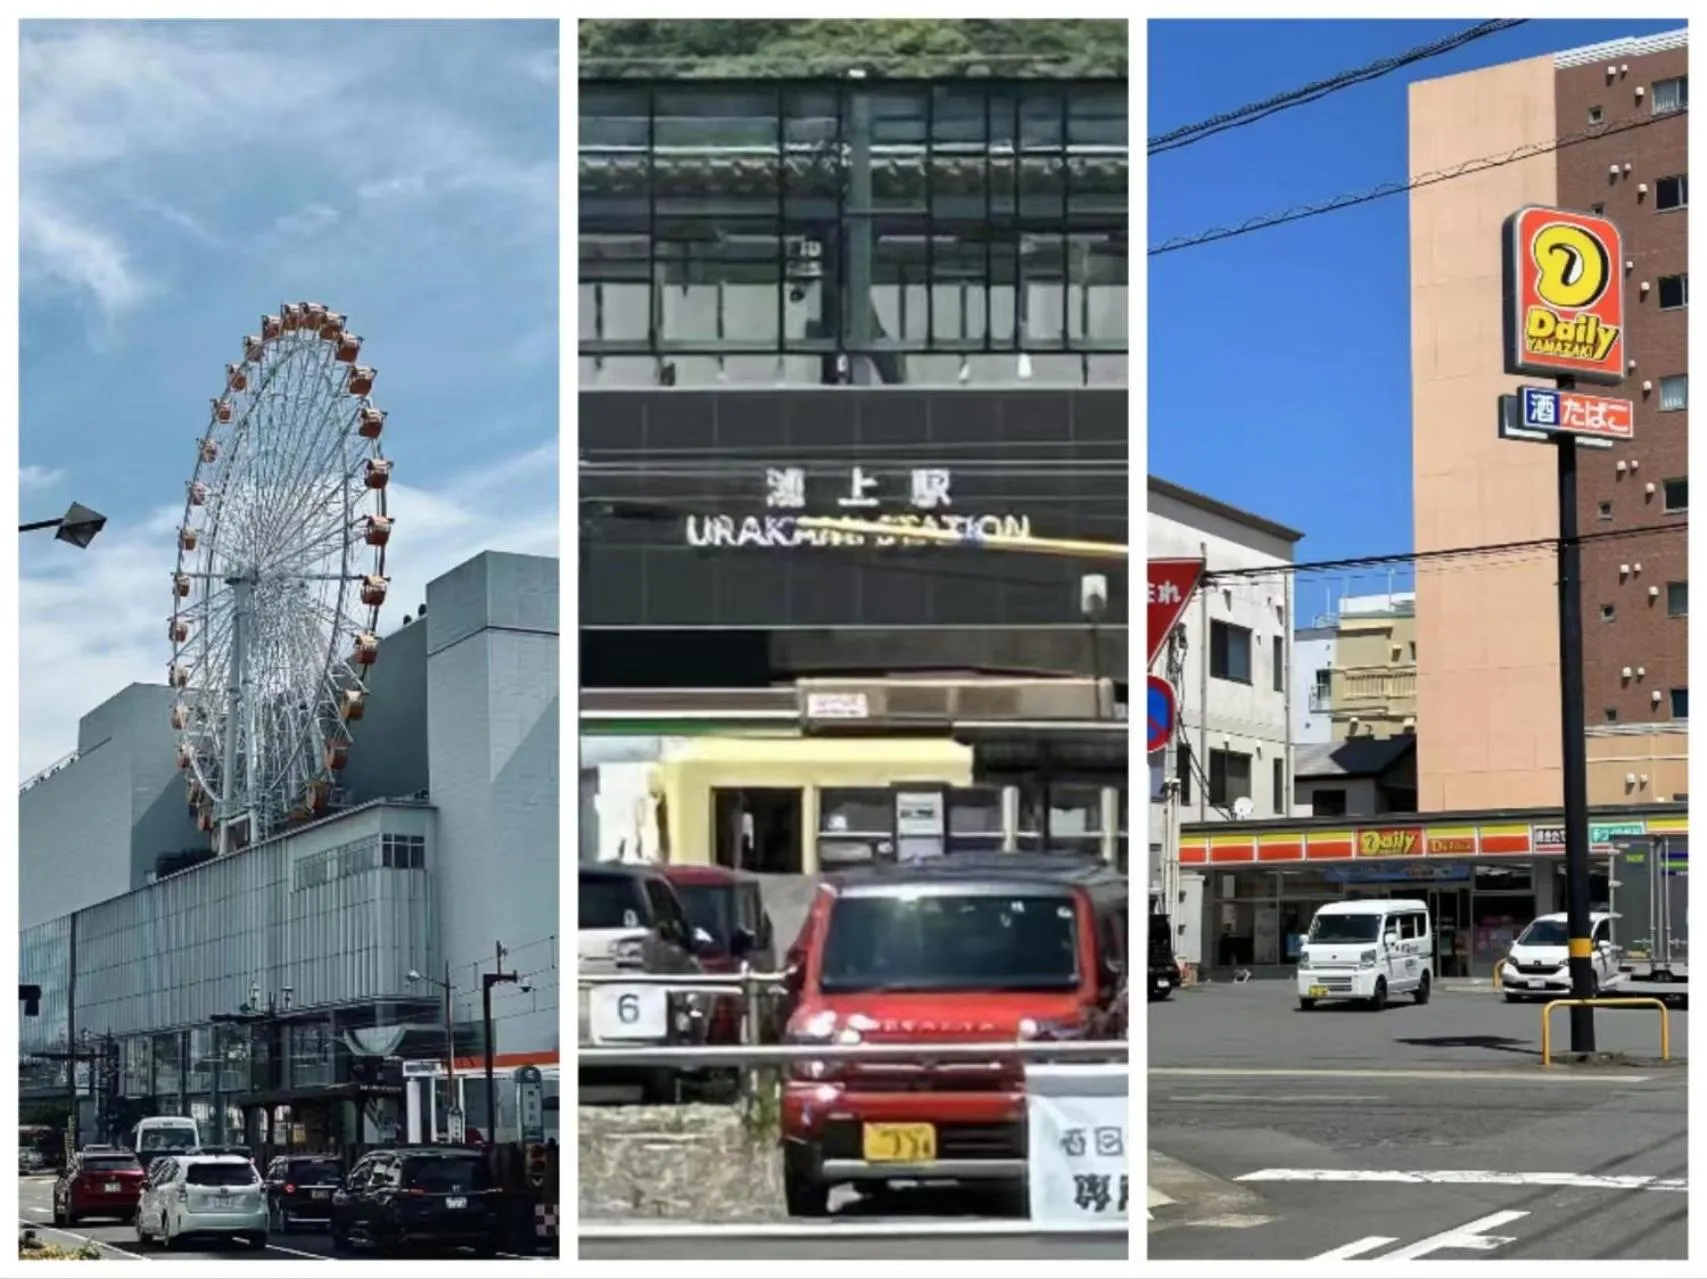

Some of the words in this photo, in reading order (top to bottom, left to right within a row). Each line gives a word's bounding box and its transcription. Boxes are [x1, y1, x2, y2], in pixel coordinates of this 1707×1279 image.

[1527, 337, 1595, 359] YAMAZAKI
[1528, 308, 1619, 360] Daily
[1530, 394, 1556, 424] 酒
[1563, 398, 1630, 433] たばこ
[1361, 829, 1417, 855] Daily
[617, 993, 640, 1023] 6
